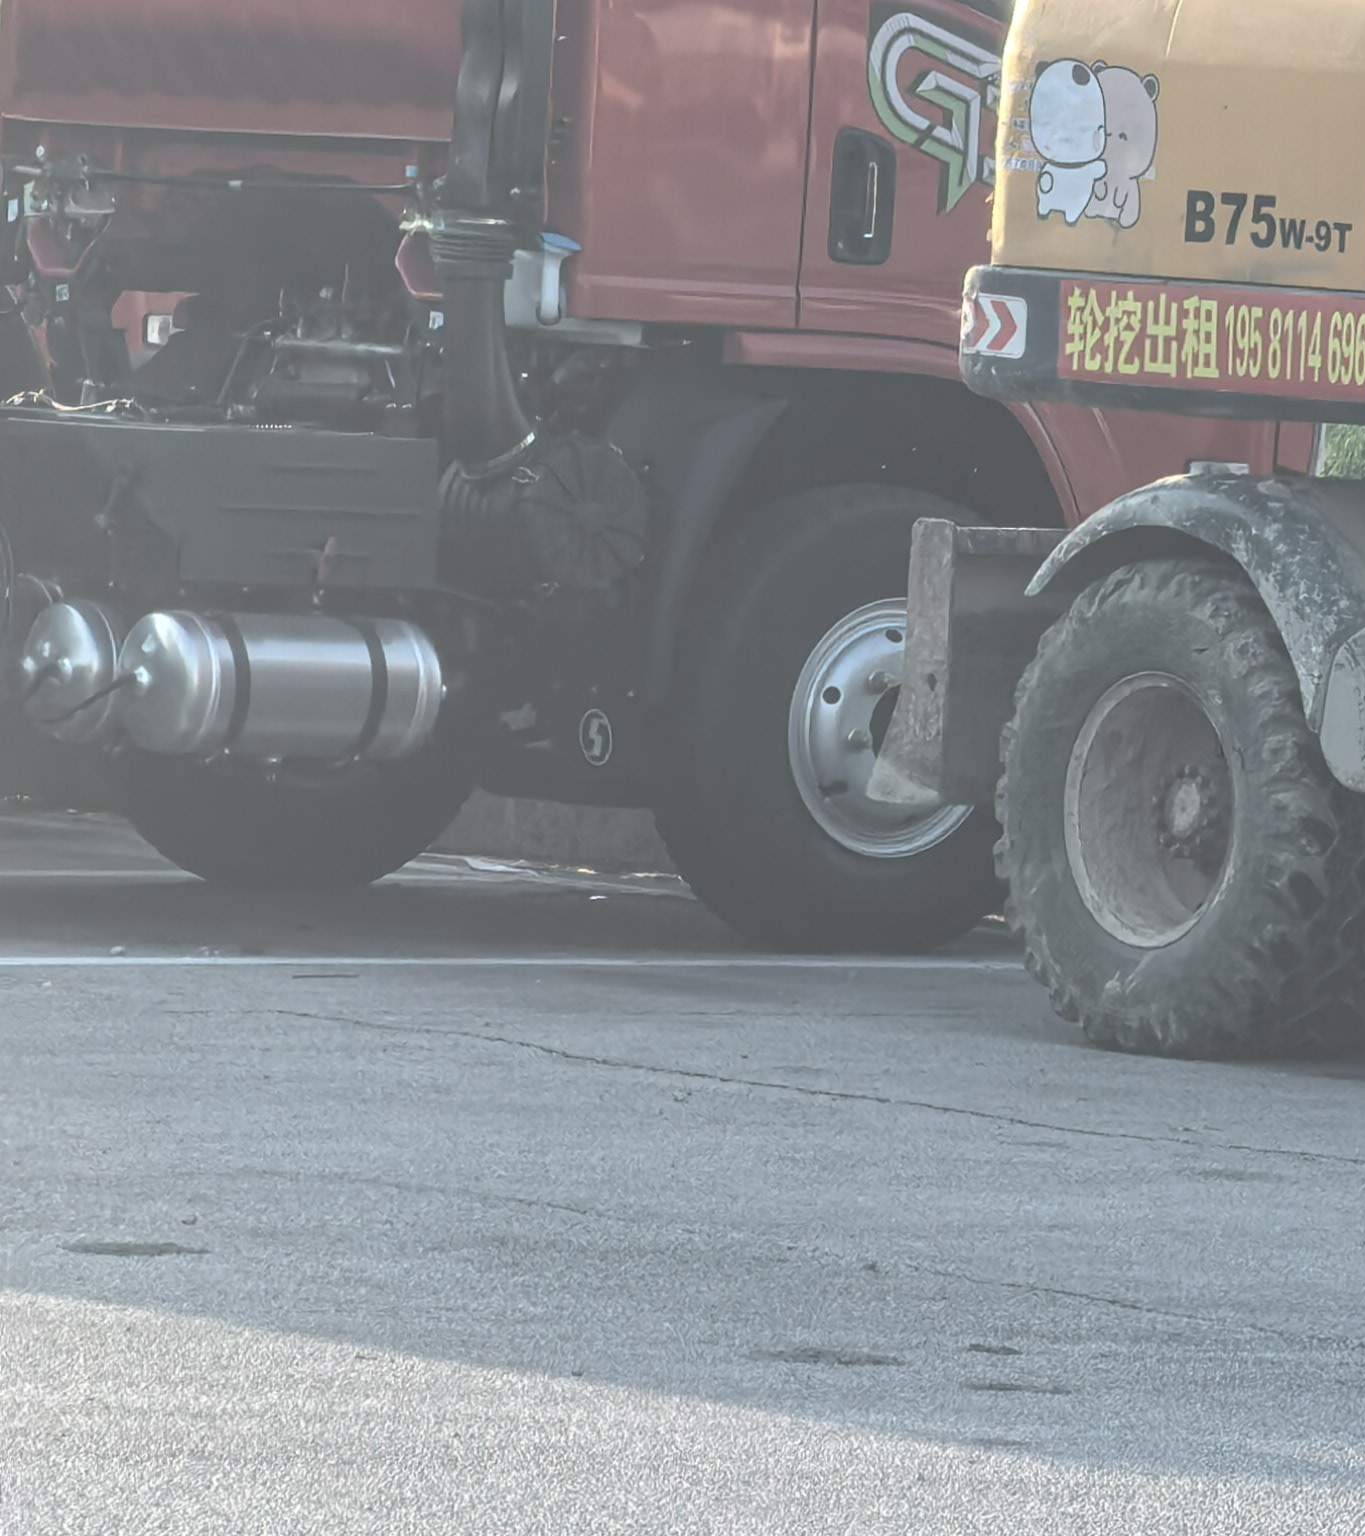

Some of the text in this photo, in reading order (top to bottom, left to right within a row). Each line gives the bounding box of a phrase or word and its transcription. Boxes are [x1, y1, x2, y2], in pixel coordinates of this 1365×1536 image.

[1184, 189, 1353, 253] B75W-9T
[1065, 285, 1220, 379] 轮挖出租
